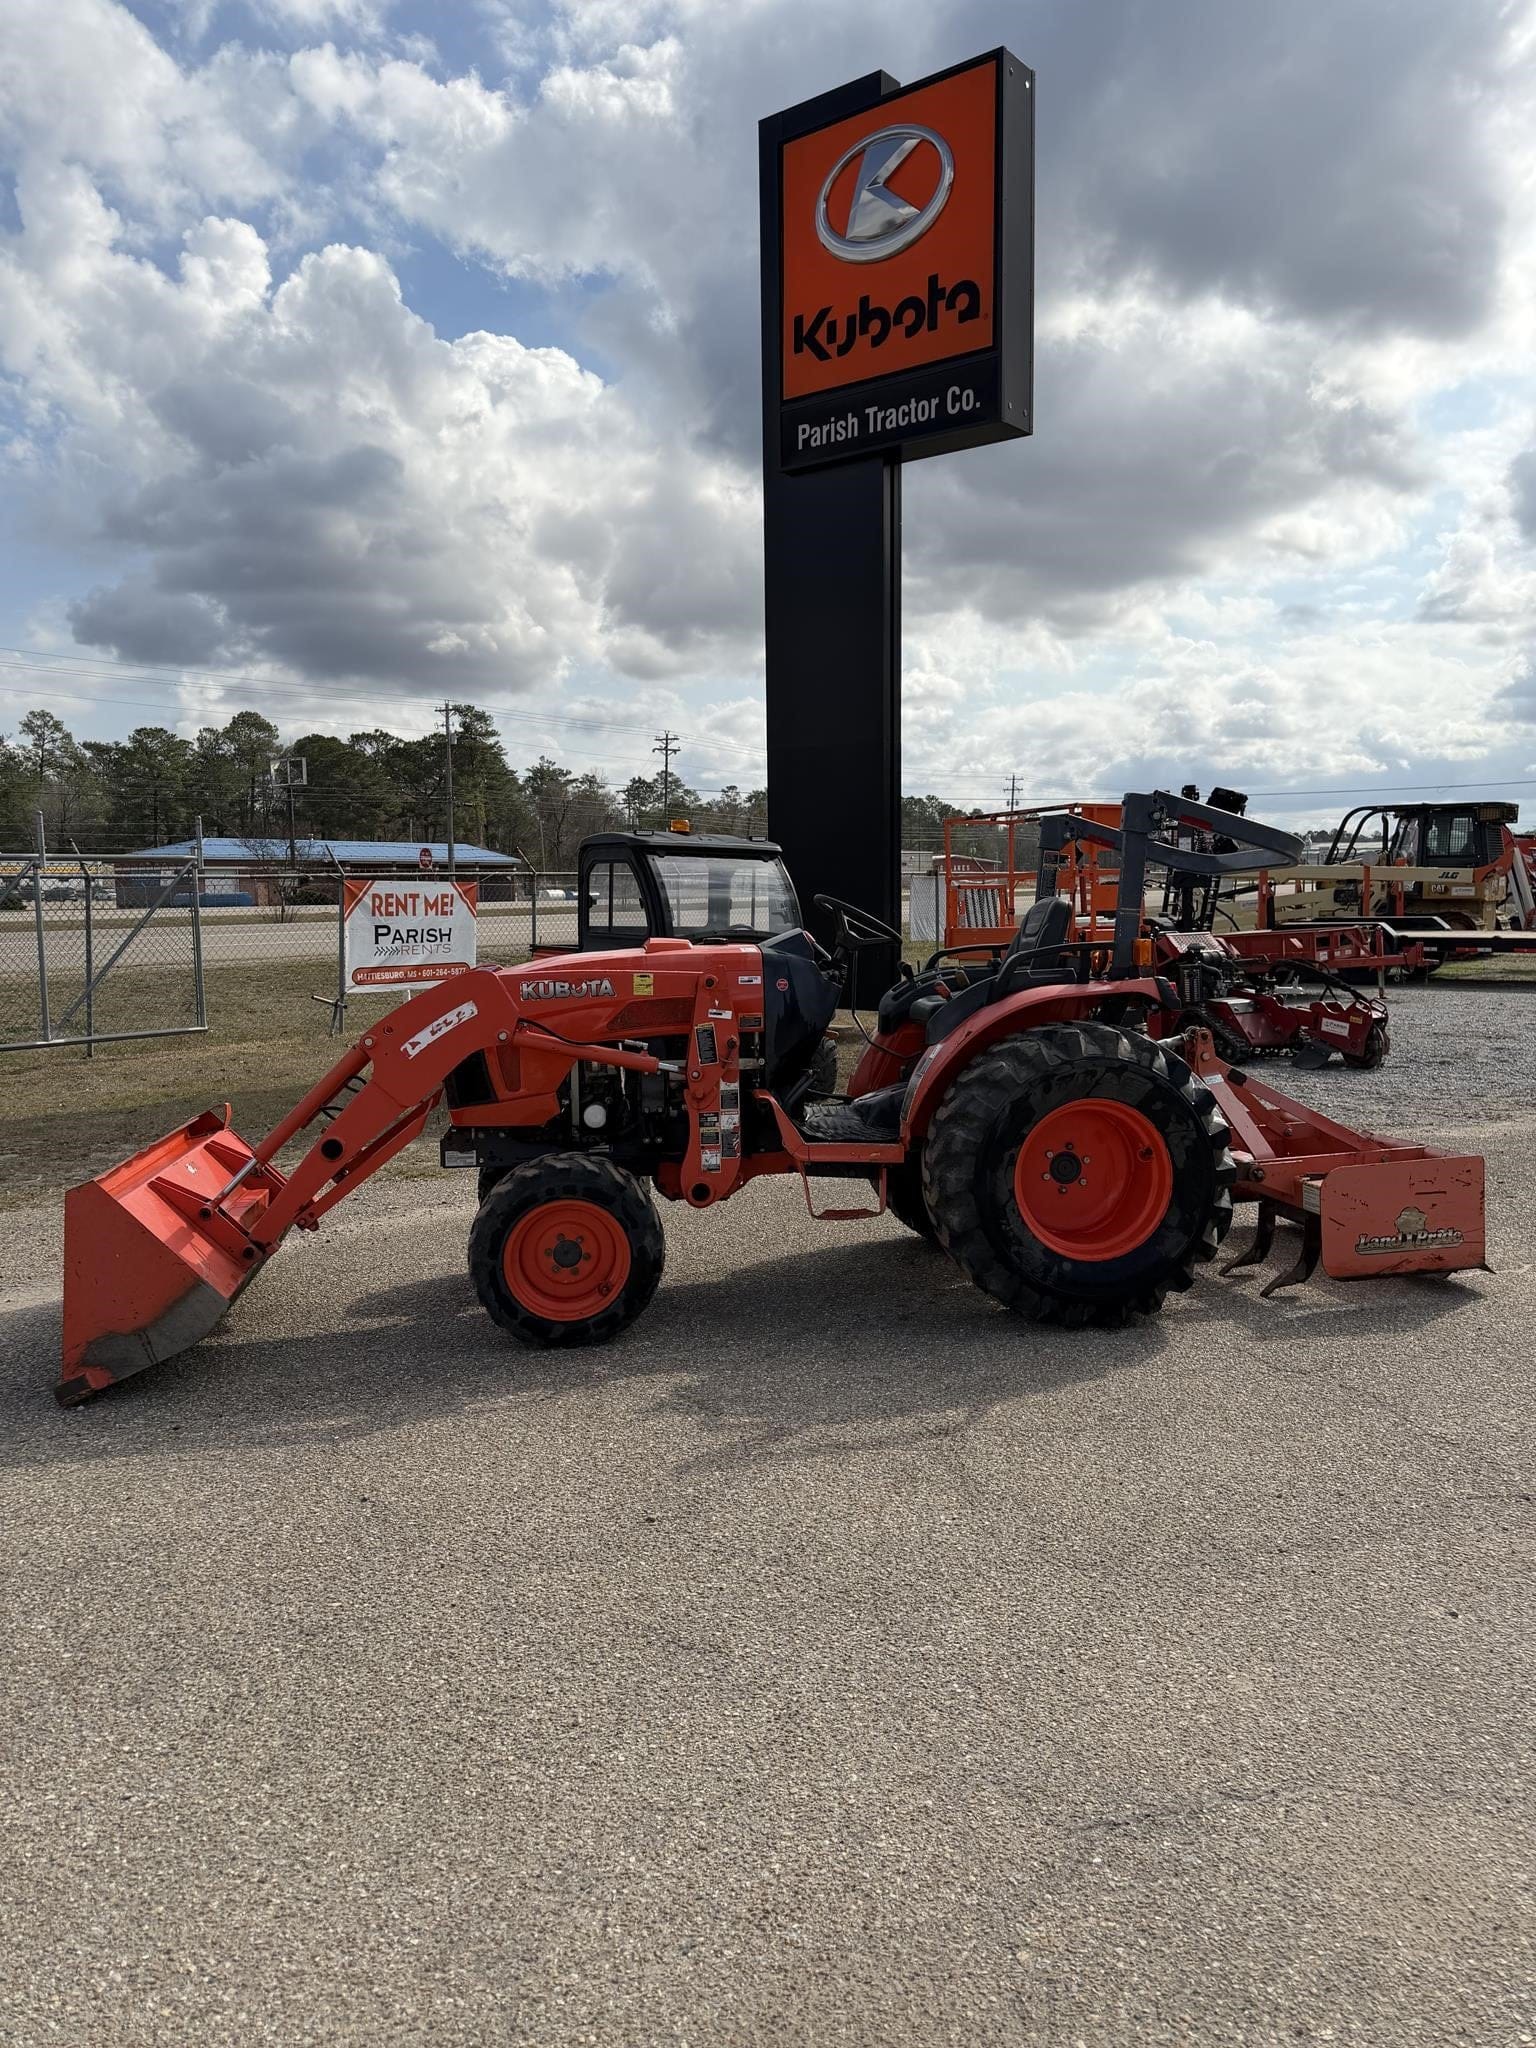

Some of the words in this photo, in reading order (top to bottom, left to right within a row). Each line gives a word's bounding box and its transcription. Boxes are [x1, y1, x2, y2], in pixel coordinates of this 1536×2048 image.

[794, 273, 981, 361] Kubota
[798, 413, 858, 449] Parish
[865, 397, 939, 433] Tractor
[947, 386, 981, 414] Co.
[1438, 871, 1460, 879] JLG
[371, 893, 420, 917] RENT
[423, 893, 454, 916] ME!
[374, 925, 452, 945] PARISH
[400, 943, 451, 955] RENTS
[407, 970, 417, 978] MS
[521, 979, 615, 1000] KUBOTA
[1357, 1232, 1402, 1250] Land
[1416, 1228, 1462, 1247] Pride
